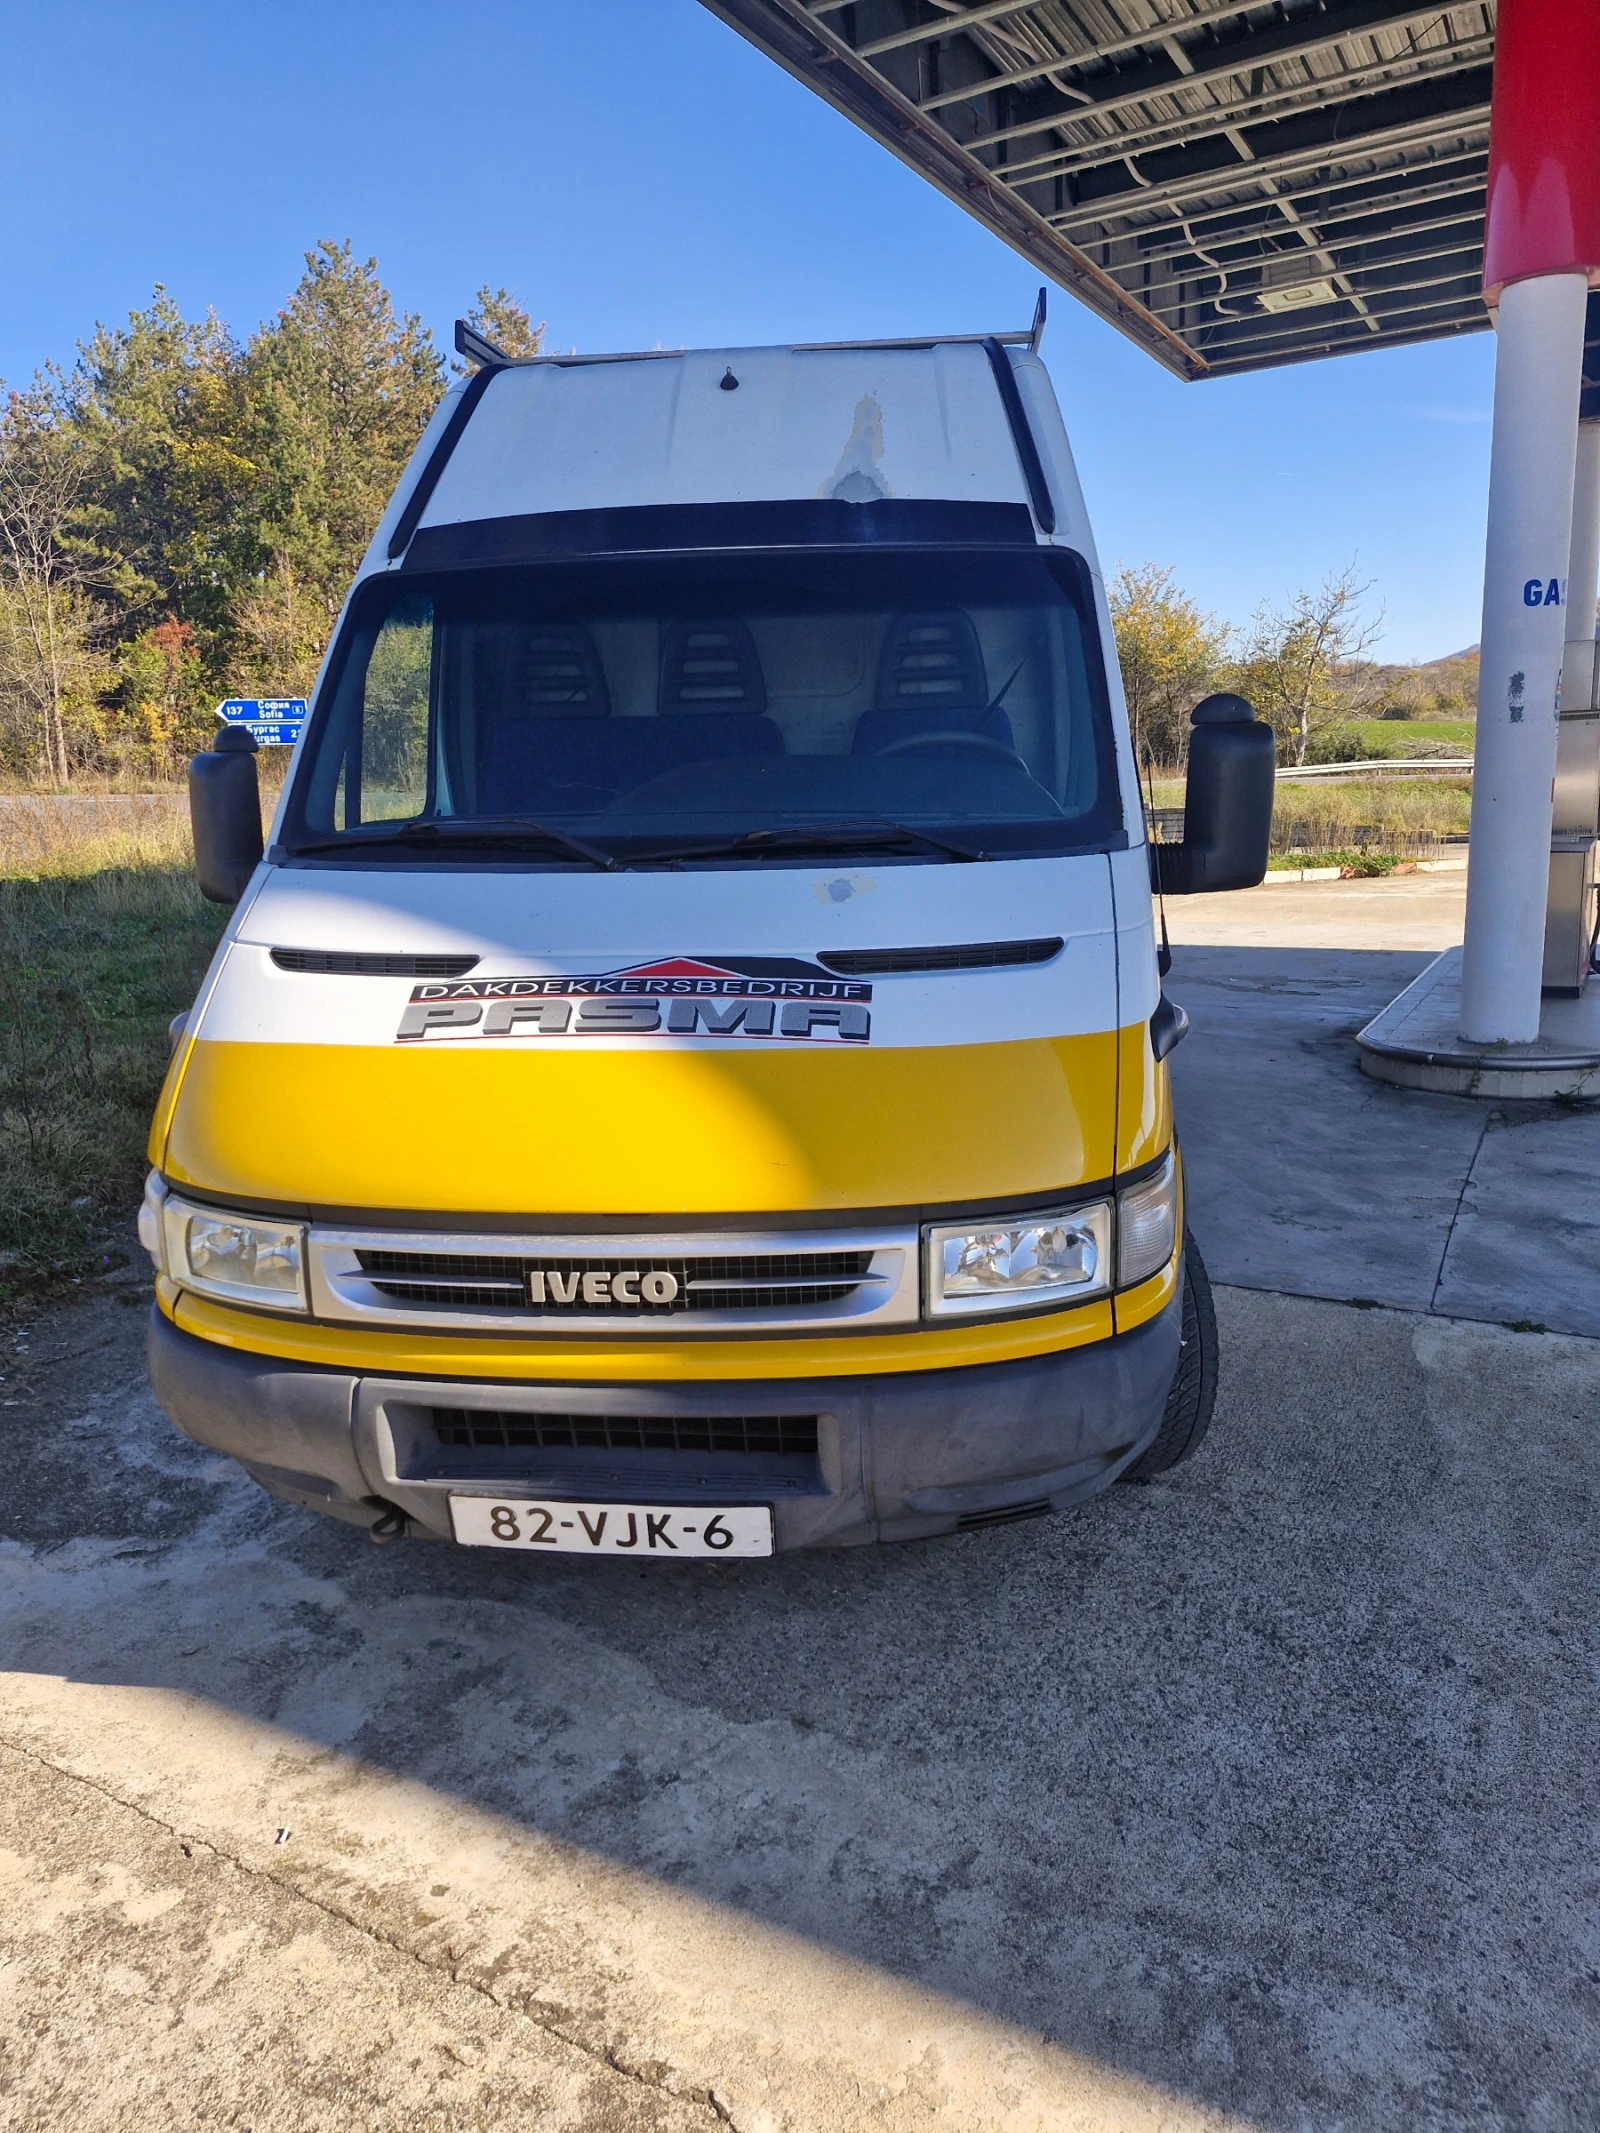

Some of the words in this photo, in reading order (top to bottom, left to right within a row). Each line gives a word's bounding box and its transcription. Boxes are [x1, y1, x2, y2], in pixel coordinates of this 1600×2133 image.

[226, 706, 243, 716] 137
[257, 701, 290, 709] София
[259, 710, 284, 719] Sofia
[255, 734, 281, 744] urgas
[420, 979, 863, 998] DAKDEKKERSBEDRIJF
[396, 998, 871, 1040] PASMA
[529, 1271, 679, 1304] IVECO
[490, 1505, 735, 1550] 82-VJK-6
